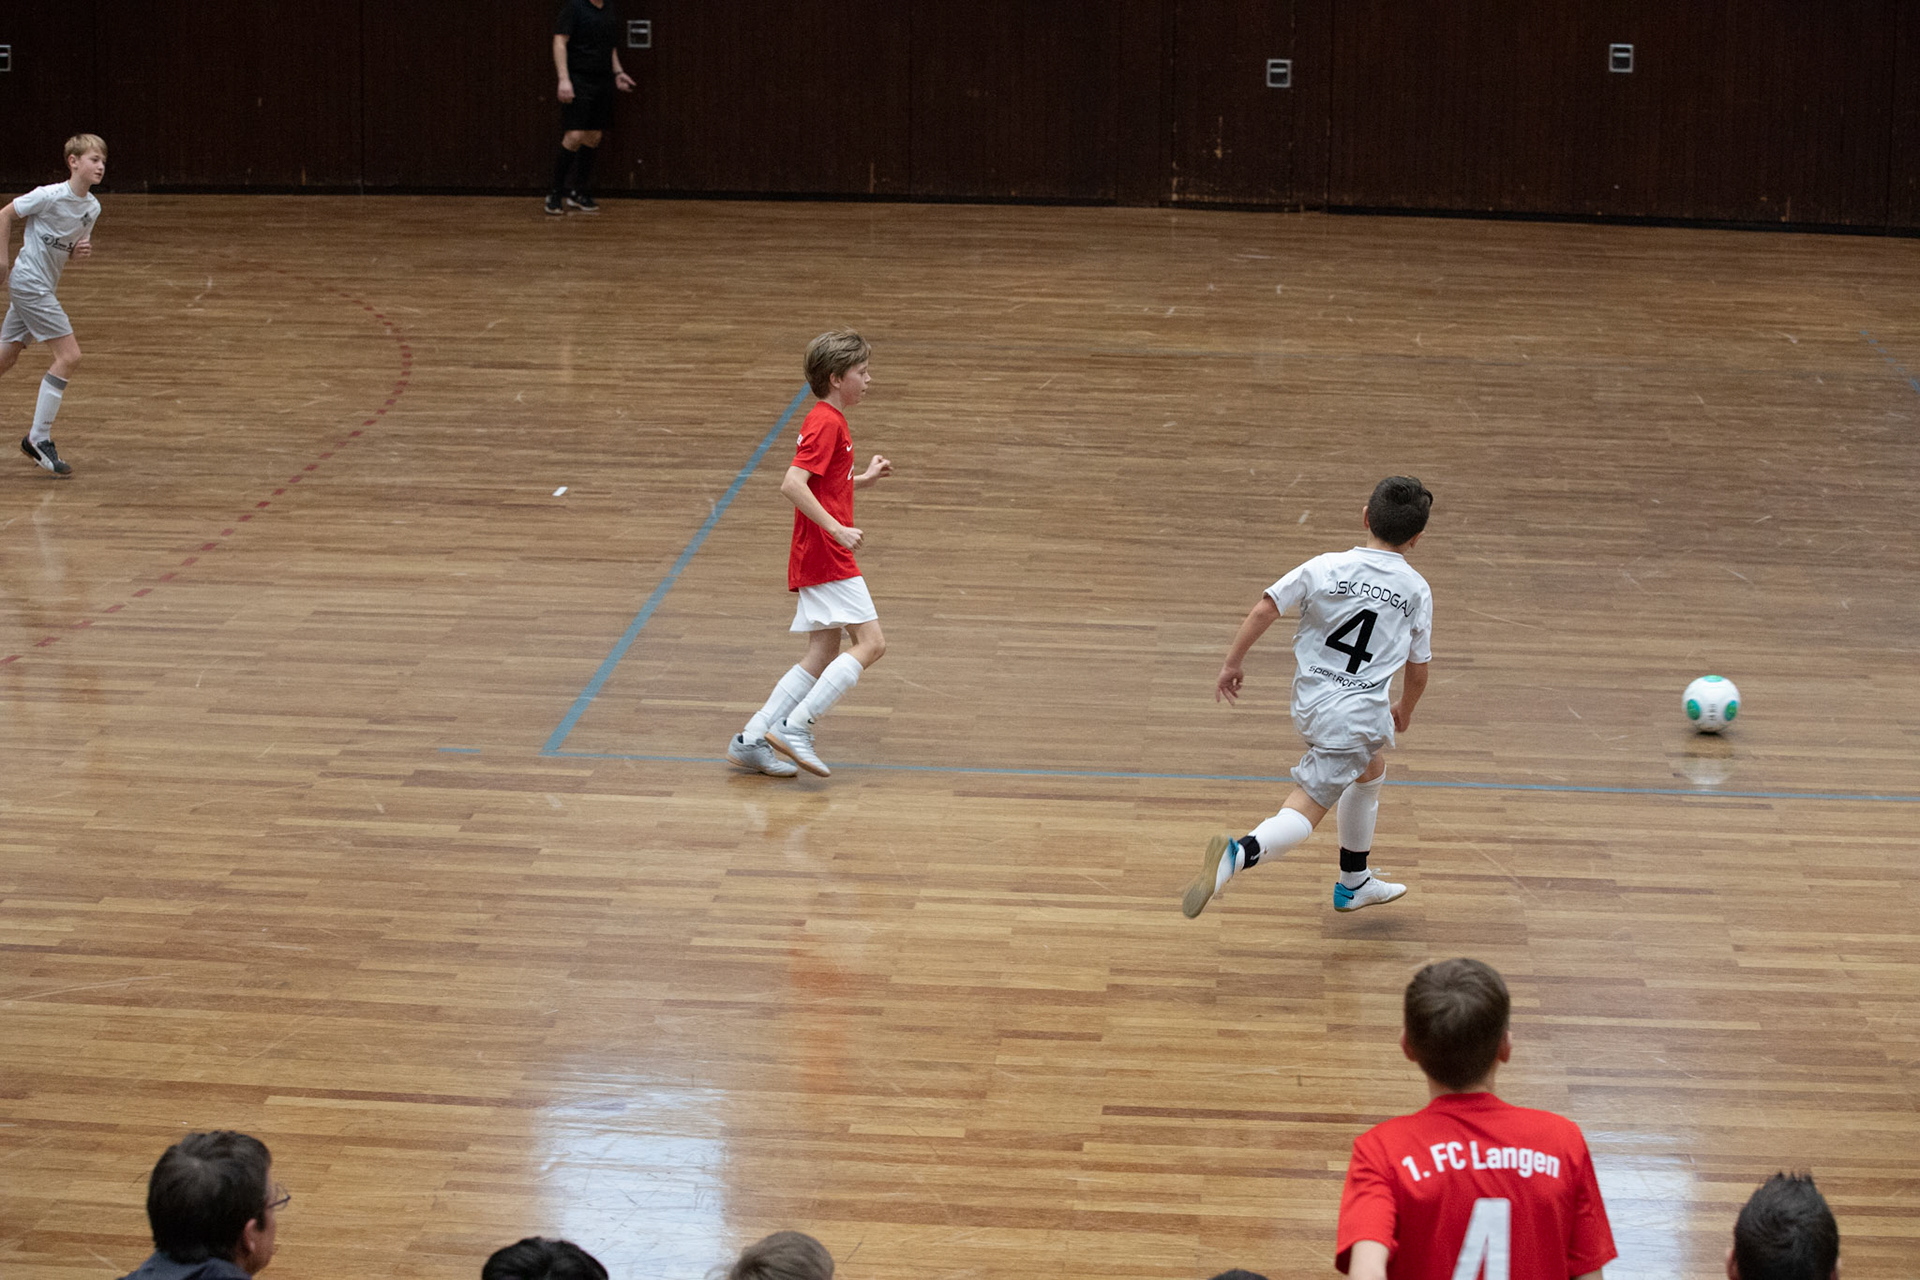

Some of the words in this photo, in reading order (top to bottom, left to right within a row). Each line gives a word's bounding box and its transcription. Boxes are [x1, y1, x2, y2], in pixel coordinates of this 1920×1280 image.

[1329, 581, 1358, 595] JSK
[1325, 608, 1378, 675] 4
[1402, 1156, 1431, 1181] 1.
[1430, 1141, 1466, 1172] FC
[1470, 1140, 1560, 1178] Langen
